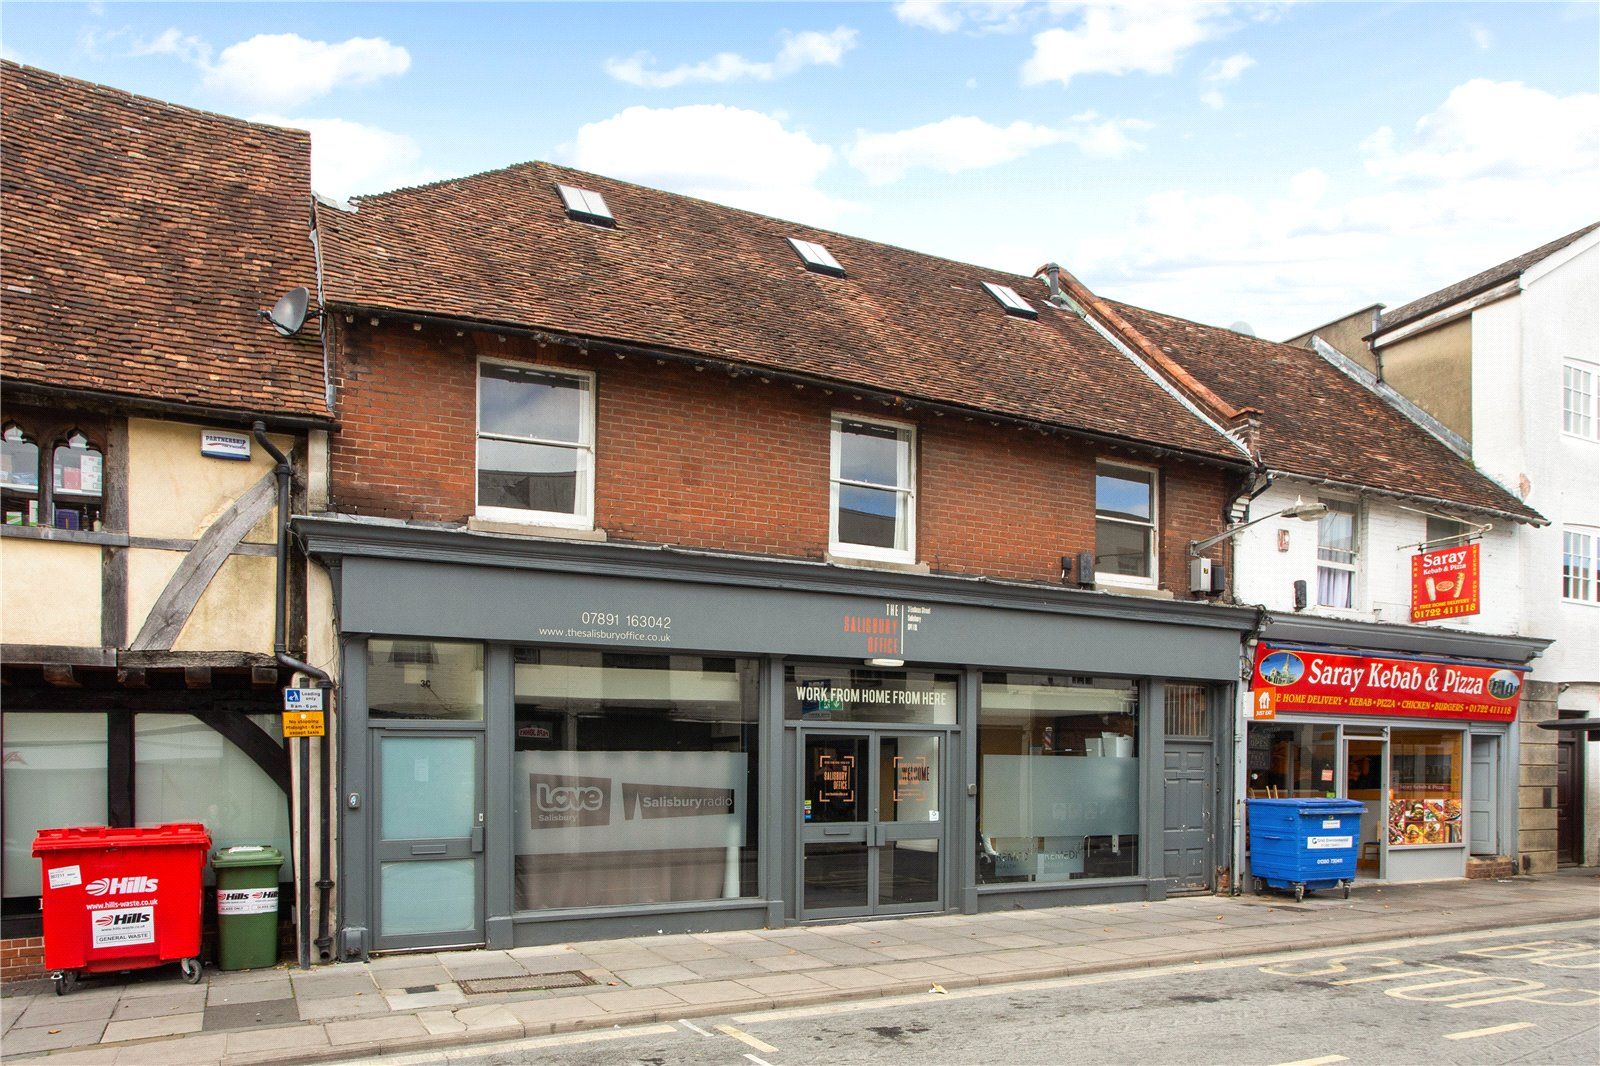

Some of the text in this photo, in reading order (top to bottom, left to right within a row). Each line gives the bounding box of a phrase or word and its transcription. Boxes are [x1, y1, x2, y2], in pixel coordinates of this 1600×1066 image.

[1423, 551, 1467, 567] Saray
[1423, 567, 1442, 575] Kebab
[886, 604, 898, 616] THE
[1414, 603, 1476, 618] 01722 411118
[582, 612, 672, 629] 07891 163042
[843, 615, 897, 634] SALISBURY
[867, 637, 897, 654] OFFICE
[1308, 658, 1483, 694] Saray Kebab & Pizza
[420, 680, 431, 688] 3C
[796, 686, 946, 706] WORK FROM HOME FROM HERE
[1282, 693, 1306, 703] HOME
[1307, 695, 1343, 705] DELIVERY
[1349, 697, 1372, 706] KEBAB
[1376, 699, 1396, 707] PIZZA
[1401, 700, 1430, 709] CHICKEN
[1434, 702, 1464, 712] BURGERS
[1469, 704, 1488, 713] 01722
[1489, 706, 1511, 714] 411118
[823, 771, 847, 781] SALISBURY
[833, 780, 847, 790] OFFICE
[538, 814, 577, 823] Salisbury
[109, 876, 158, 895] Hills
[86, 899, 158, 910] www.hills-waste.co.uk
[114, 913, 150, 925] Hills
